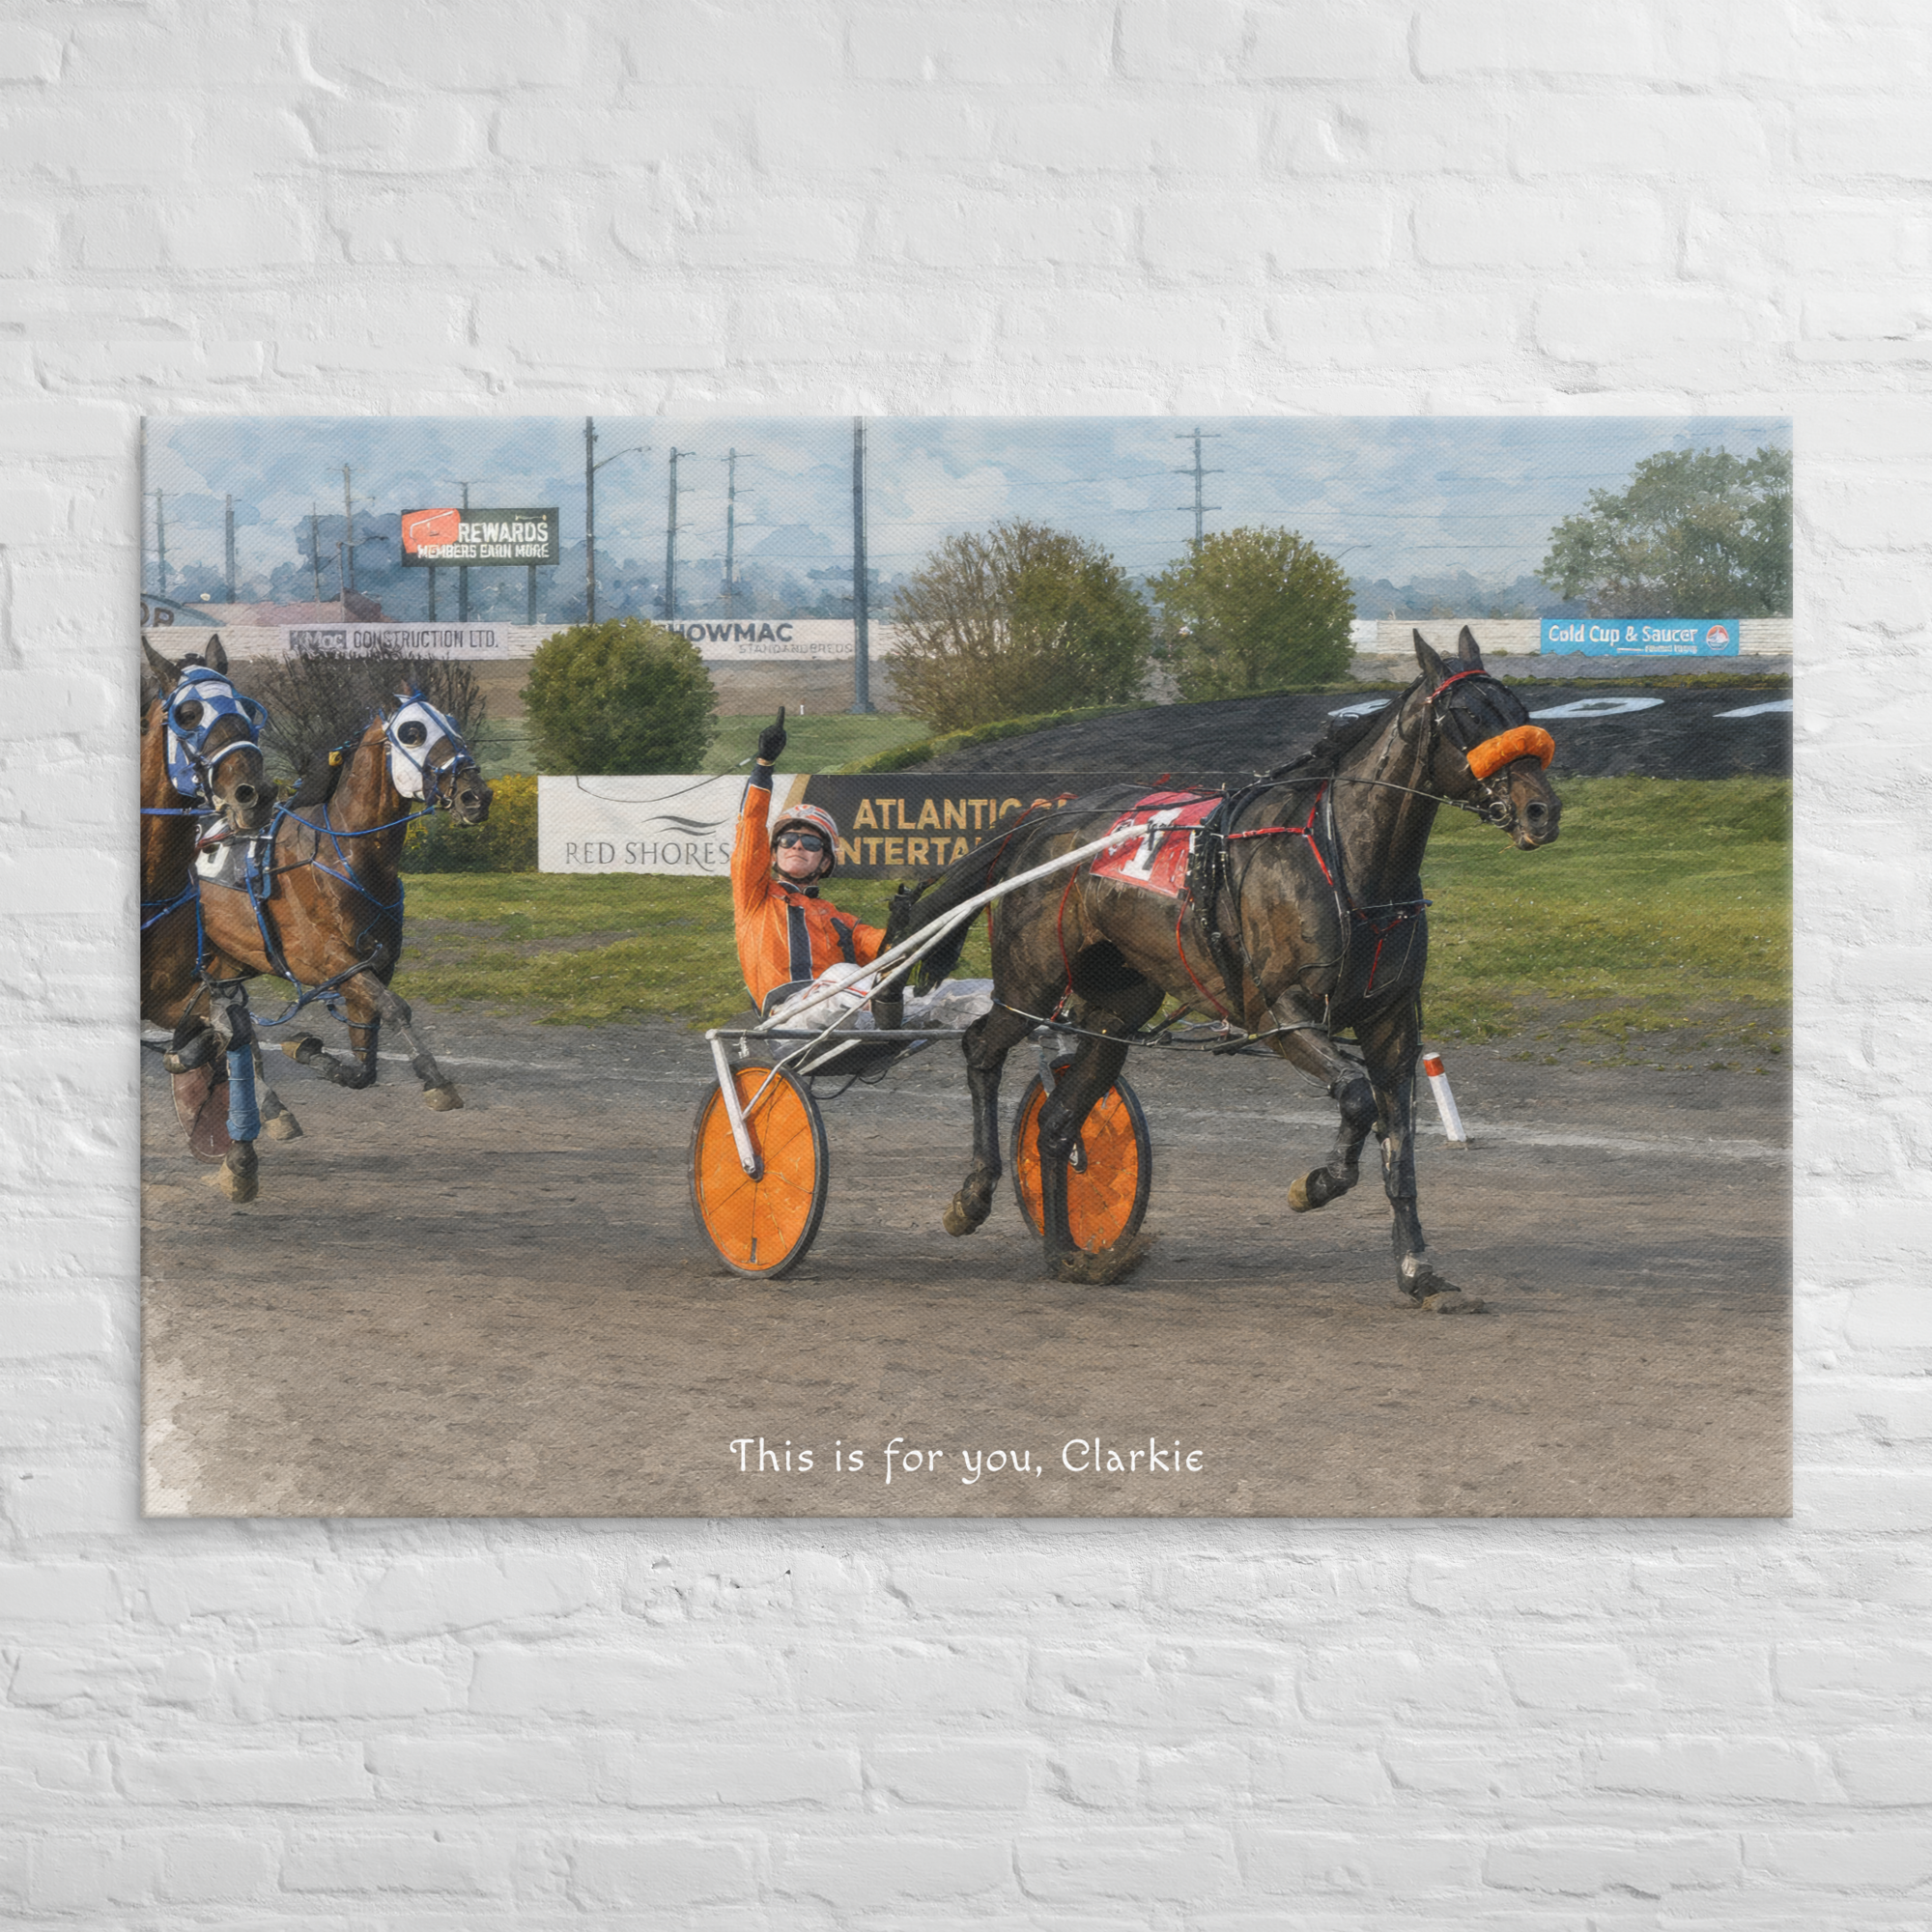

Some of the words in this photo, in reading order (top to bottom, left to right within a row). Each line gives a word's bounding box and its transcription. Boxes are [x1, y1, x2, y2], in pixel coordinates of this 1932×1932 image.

[458, 522, 549, 543] REWARDS
[417, 544, 477, 559] MEMBERS
[515, 543, 550, 558] MORE
[469, 630, 499, 648] LTD.
[663, 623, 794, 642] HOWMAC
[1589, 625, 1620, 646] Cup
[1625, 625, 1638, 642] &
[1642, 626, 1699, 643] Saucer
[566, 842, 615, 866] RED
[625, 842, 730, 872] SHORES
[837, 837, 982, 866] NTERTA
